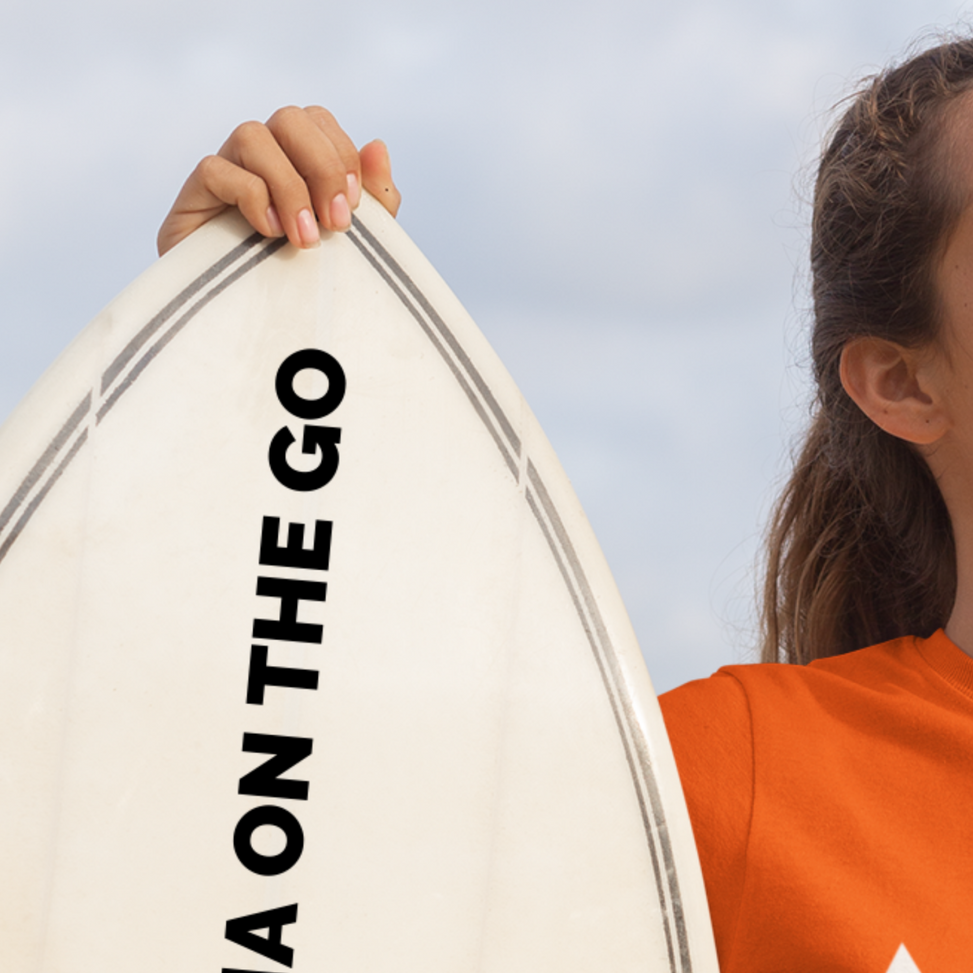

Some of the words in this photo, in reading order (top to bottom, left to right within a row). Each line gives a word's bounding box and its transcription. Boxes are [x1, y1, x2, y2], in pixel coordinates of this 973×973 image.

[268, 348, 347, 492] GO
[246, 515, 334, 706] THE
[232, 732, 314, 876] ON
